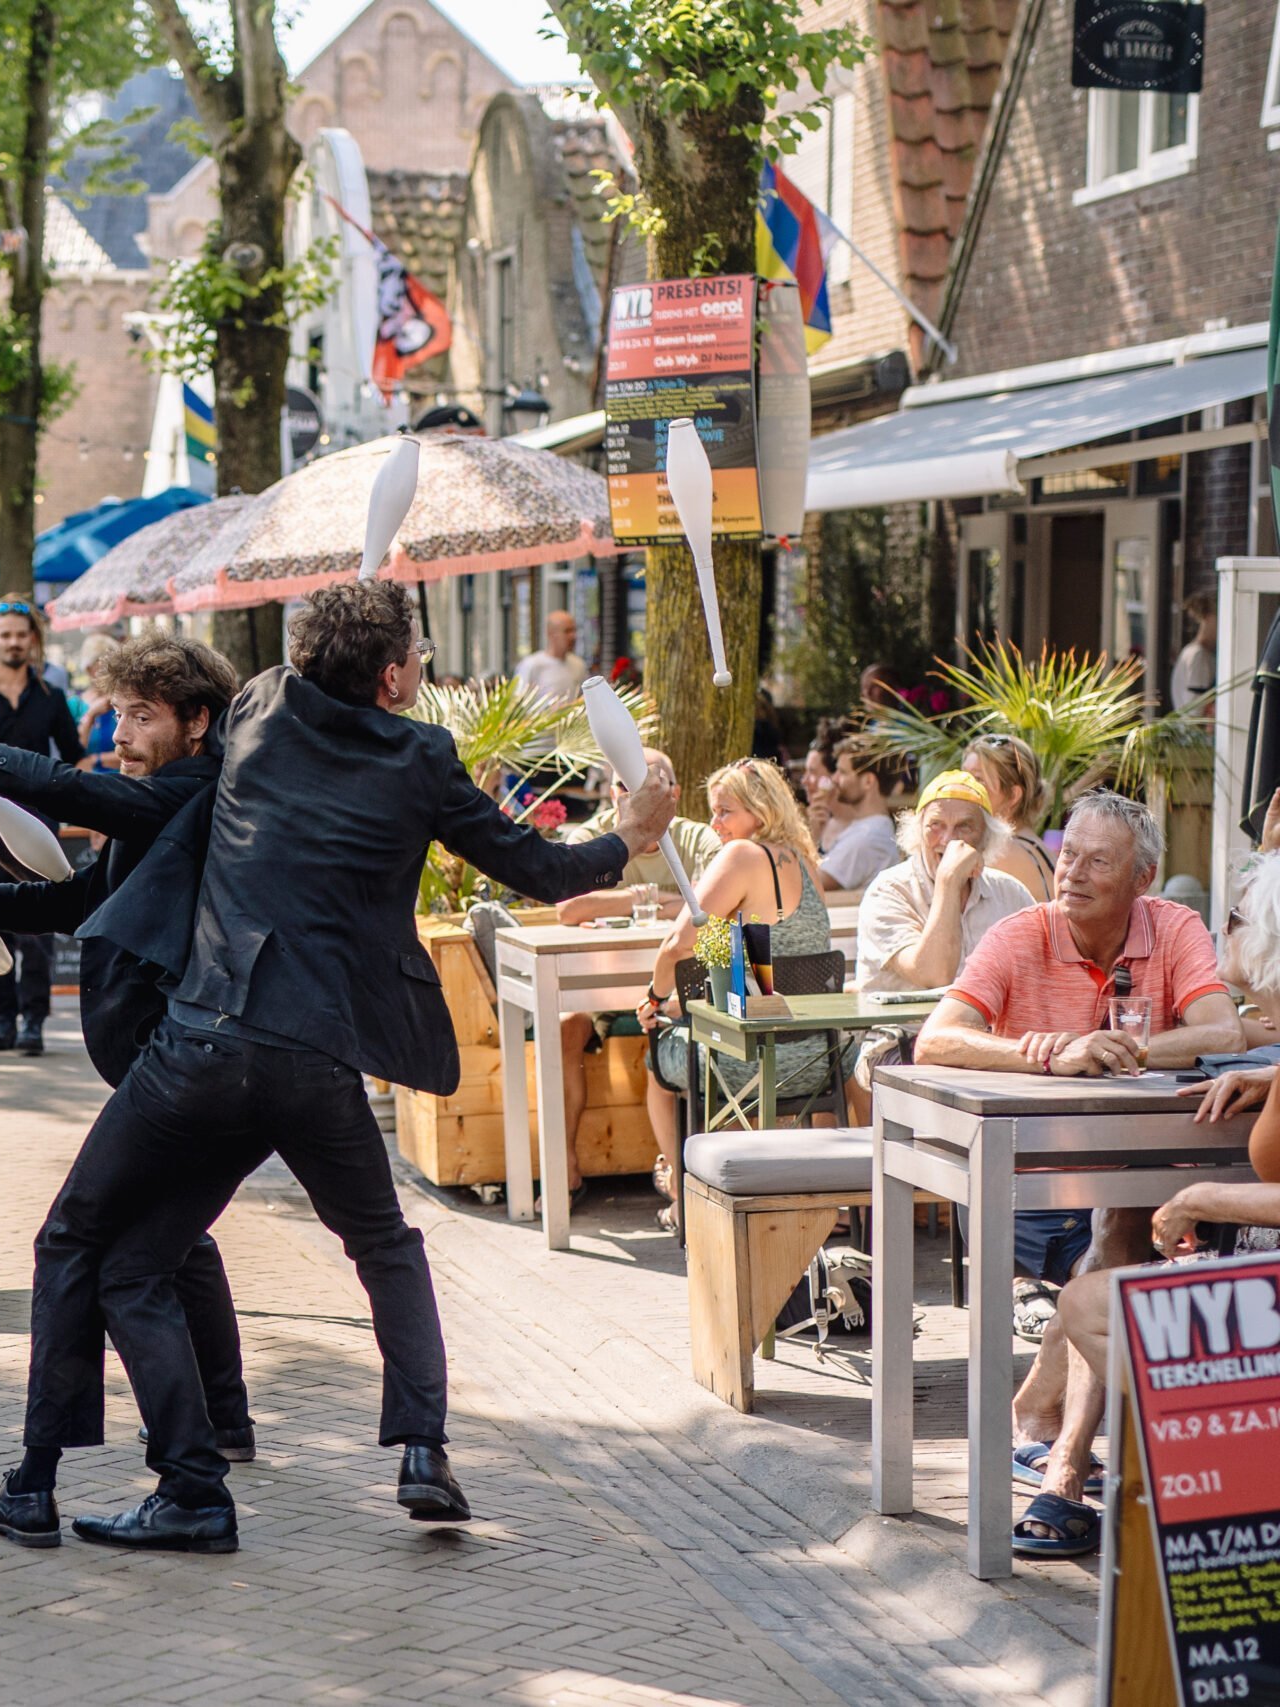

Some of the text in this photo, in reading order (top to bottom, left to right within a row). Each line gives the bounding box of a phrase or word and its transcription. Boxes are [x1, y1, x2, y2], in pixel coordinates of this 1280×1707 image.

[614, 287, 653, 320] WYB
[657, 280, 742, 300] PRESENTS!
[700, 298, 743, 315] oerol
[654, 355, 674, 368] Club
[701, 353, 712, 363] DJ
[1130, 1278, 1280, 1362] WYB
[1151, 1406, 1280, 1441] VR.9 & ZA.1
[1161, 1470, 1222, 1499] ZO.11
[1165, 1522, 1280, 1557] MA T/M D
[1188, 1637, 1260, 1669] MA.12
[1192, 1673, 1250, 1704] DI.13
